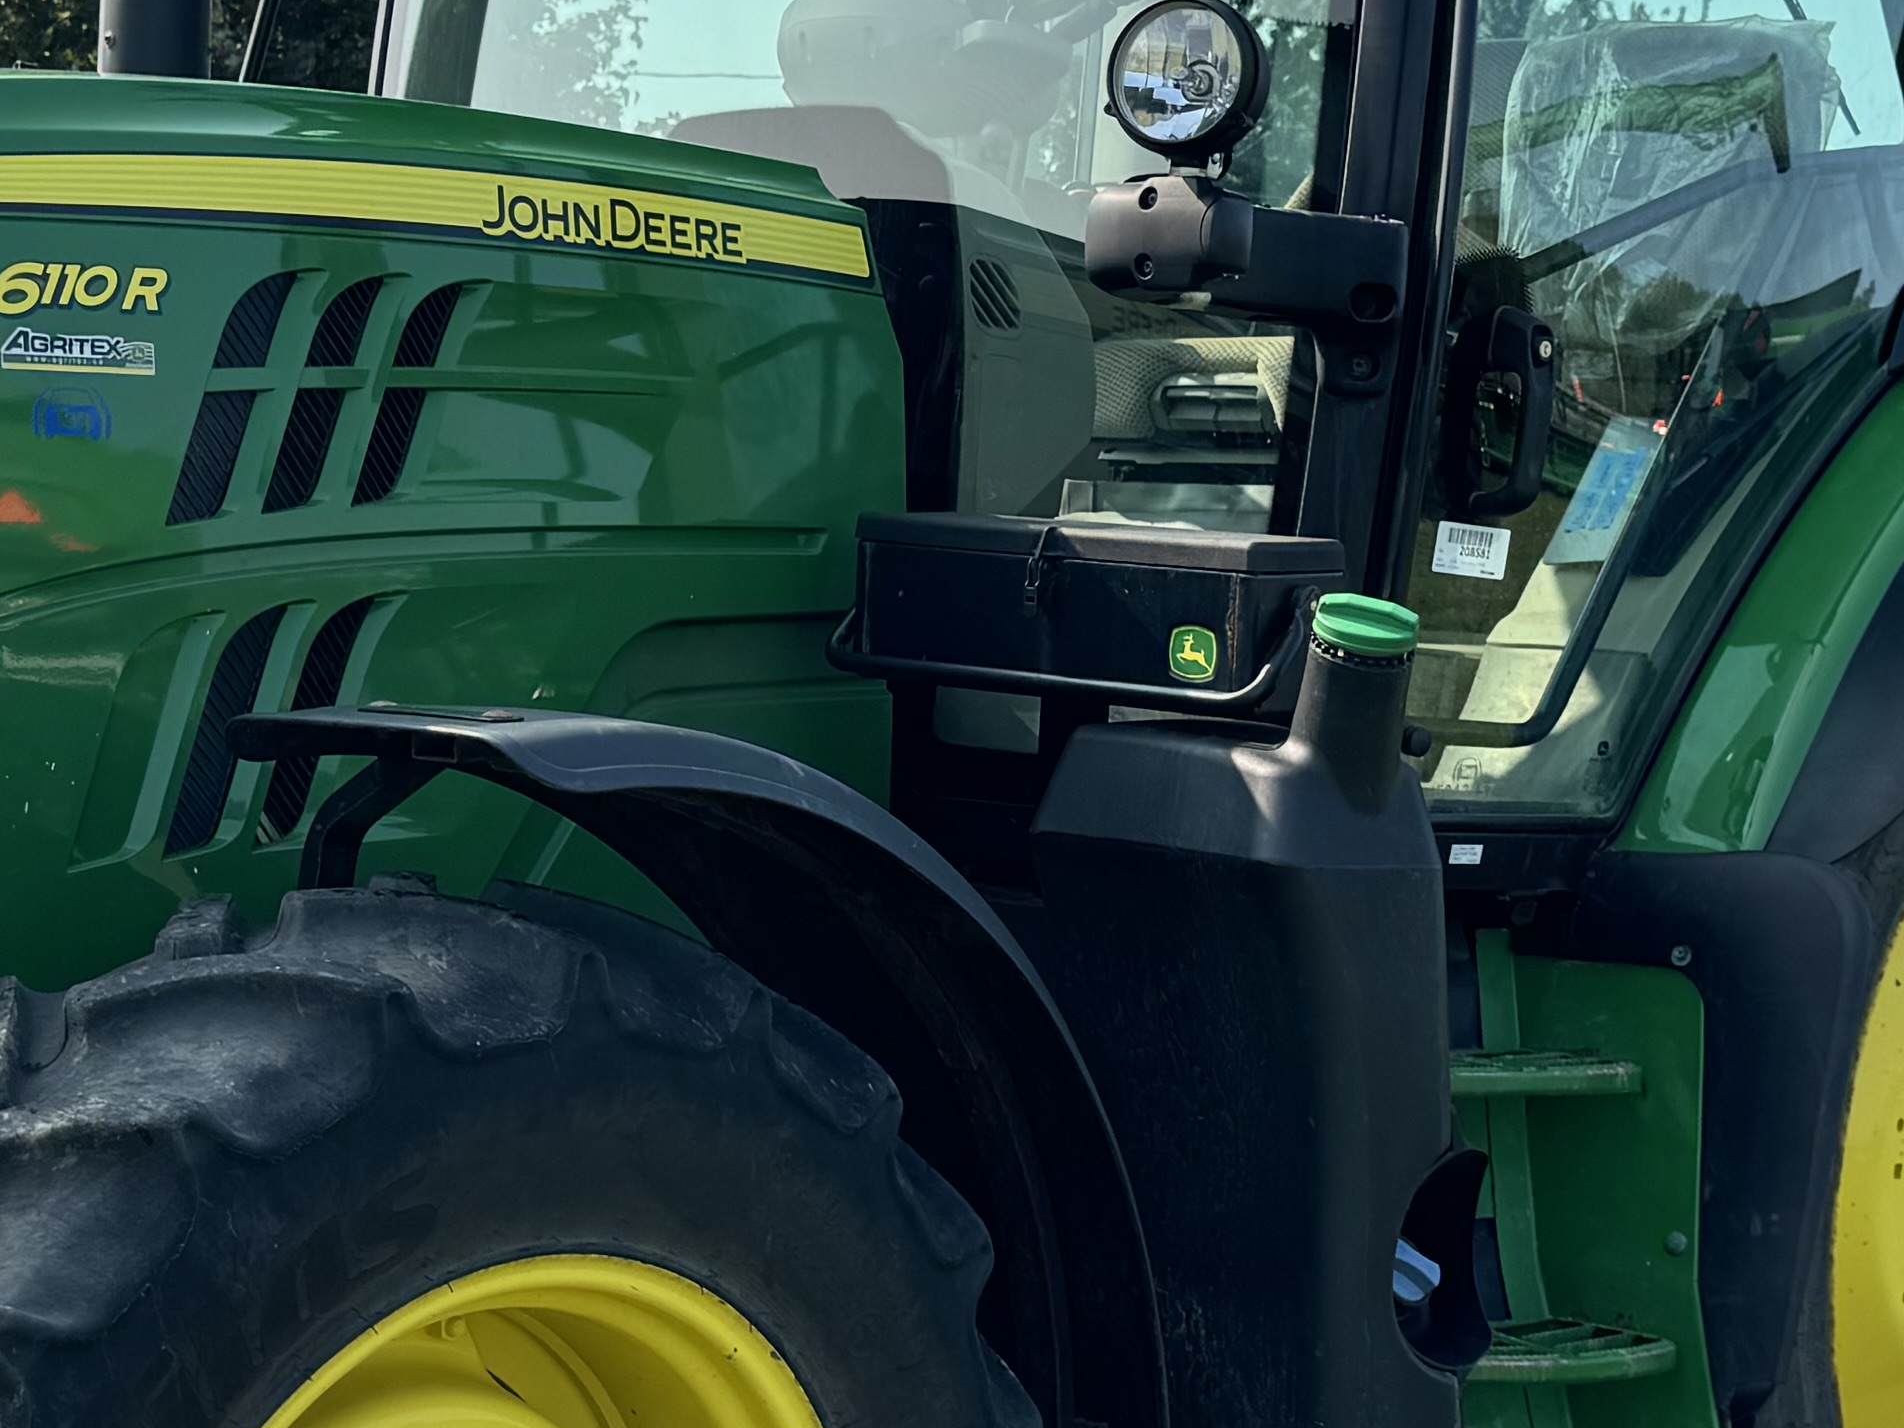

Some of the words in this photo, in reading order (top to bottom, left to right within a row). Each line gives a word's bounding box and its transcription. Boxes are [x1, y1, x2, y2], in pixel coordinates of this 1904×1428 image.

[483, 184, 602, 240] JOHN
[610, 198, 744, 258] DEERE
[4, 329, 122, 358] AGRITEX
